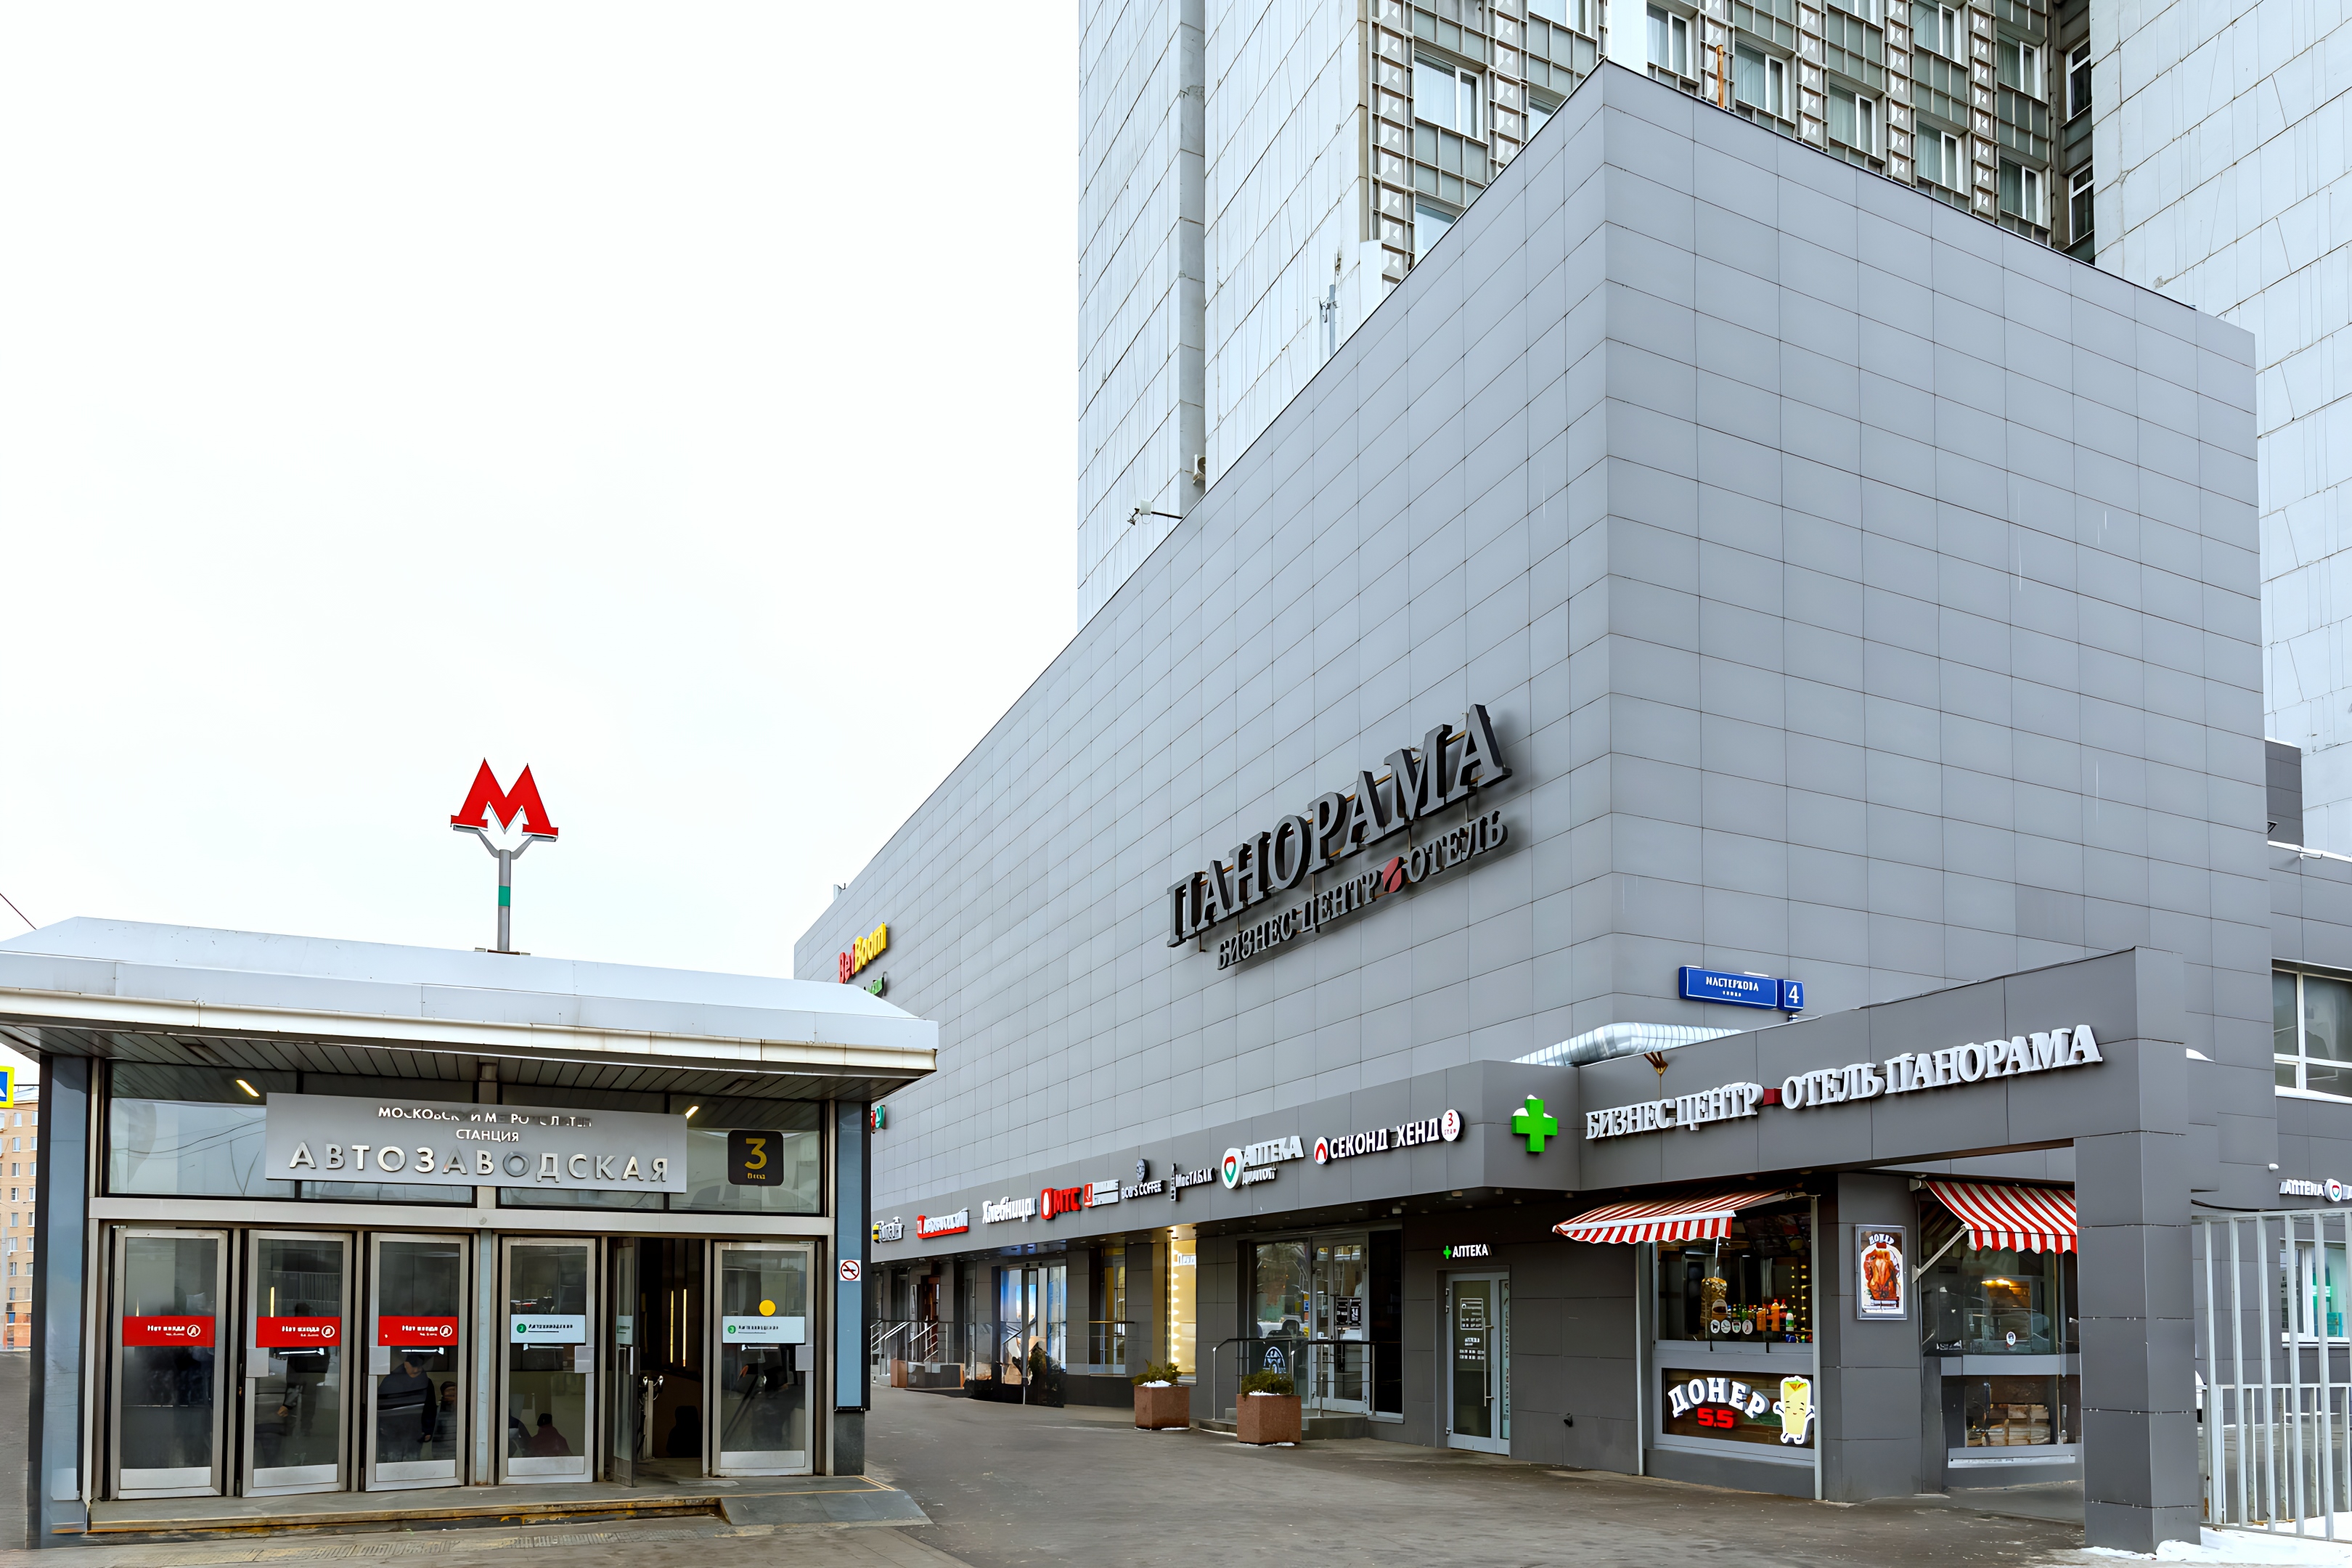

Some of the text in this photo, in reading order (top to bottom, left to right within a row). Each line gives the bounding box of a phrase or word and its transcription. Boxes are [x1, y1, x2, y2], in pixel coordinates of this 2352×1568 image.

[1167, 703, 1512, 948] ПАНОРАМА
[1217, 810, 1509, 971] БИЗНЕС ЦЕНТР ОТЕЛЬ
[1788, 984, 1800, 1004] 4
[1585, 1024, 2104, 1141] БИЗНЕС ЦЕНТР ОТЕЛЬ ПАНОРАМА
[455, 1129, 520, 1143] СТАНЦИЯ
[1244, 1135, 1304, 1167] АПТЕКА
[1329, 1117, 1440, 1159] СЕКОНД ХЕНД
[289, 1141, 668, 1183] АВТОЗАВОДСКАЯ
[744, 1138, 767, 1170] 3
[982, 1196, 1037, 1224] Хлебница
[1053, 1187, 1082, 1214] МТС
[1452, 1244, 1490, 1258] АПТЕКА
[1668, 1377, 1770, 1418] ДОНЕР
